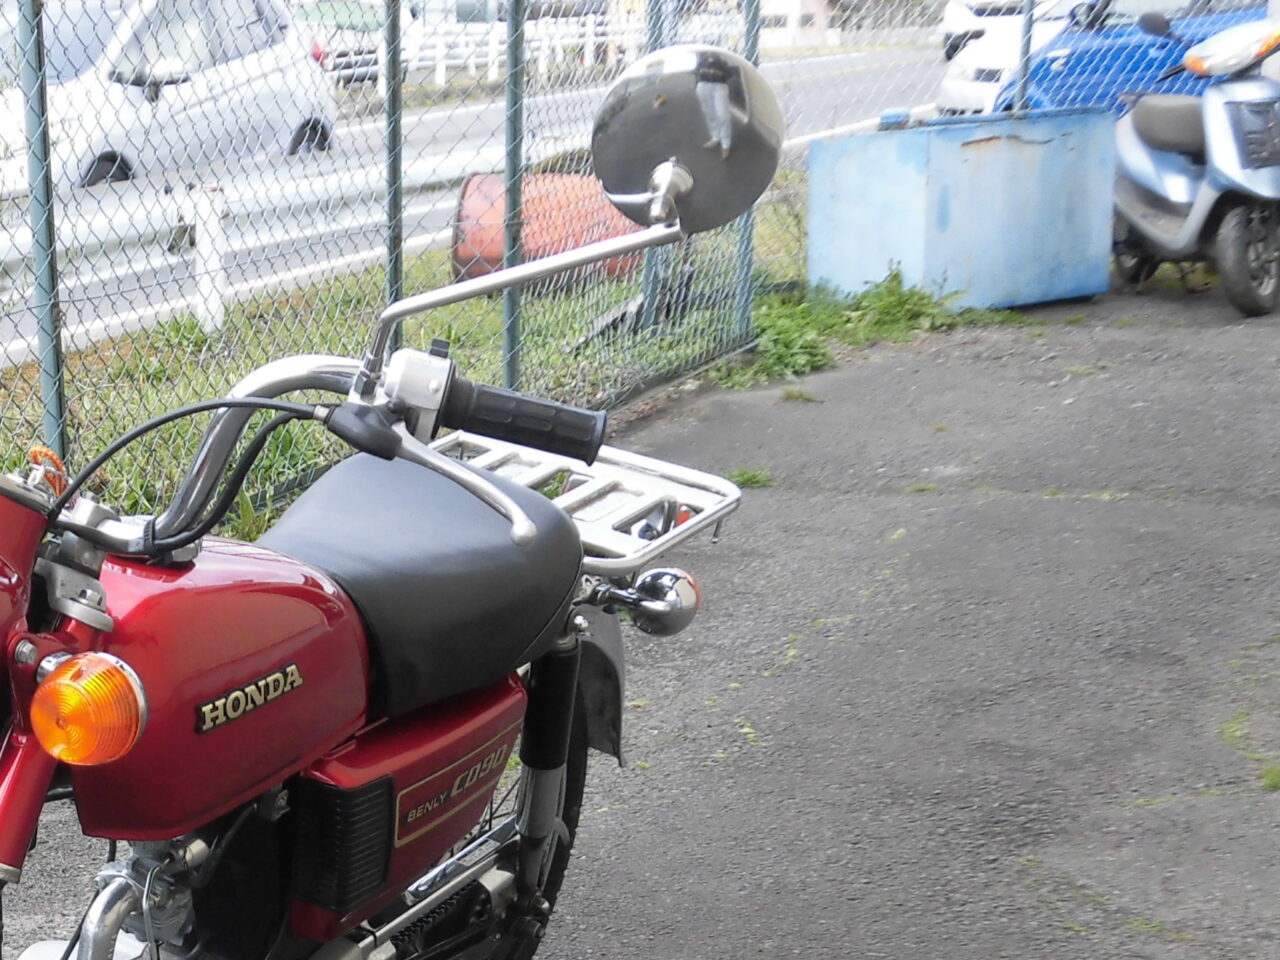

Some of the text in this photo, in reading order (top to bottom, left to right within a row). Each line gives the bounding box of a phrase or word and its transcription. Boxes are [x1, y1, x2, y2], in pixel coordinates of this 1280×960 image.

[201, 664, 303, 731] HONDA
[407, 744, 508, 822] BENLY CD90
